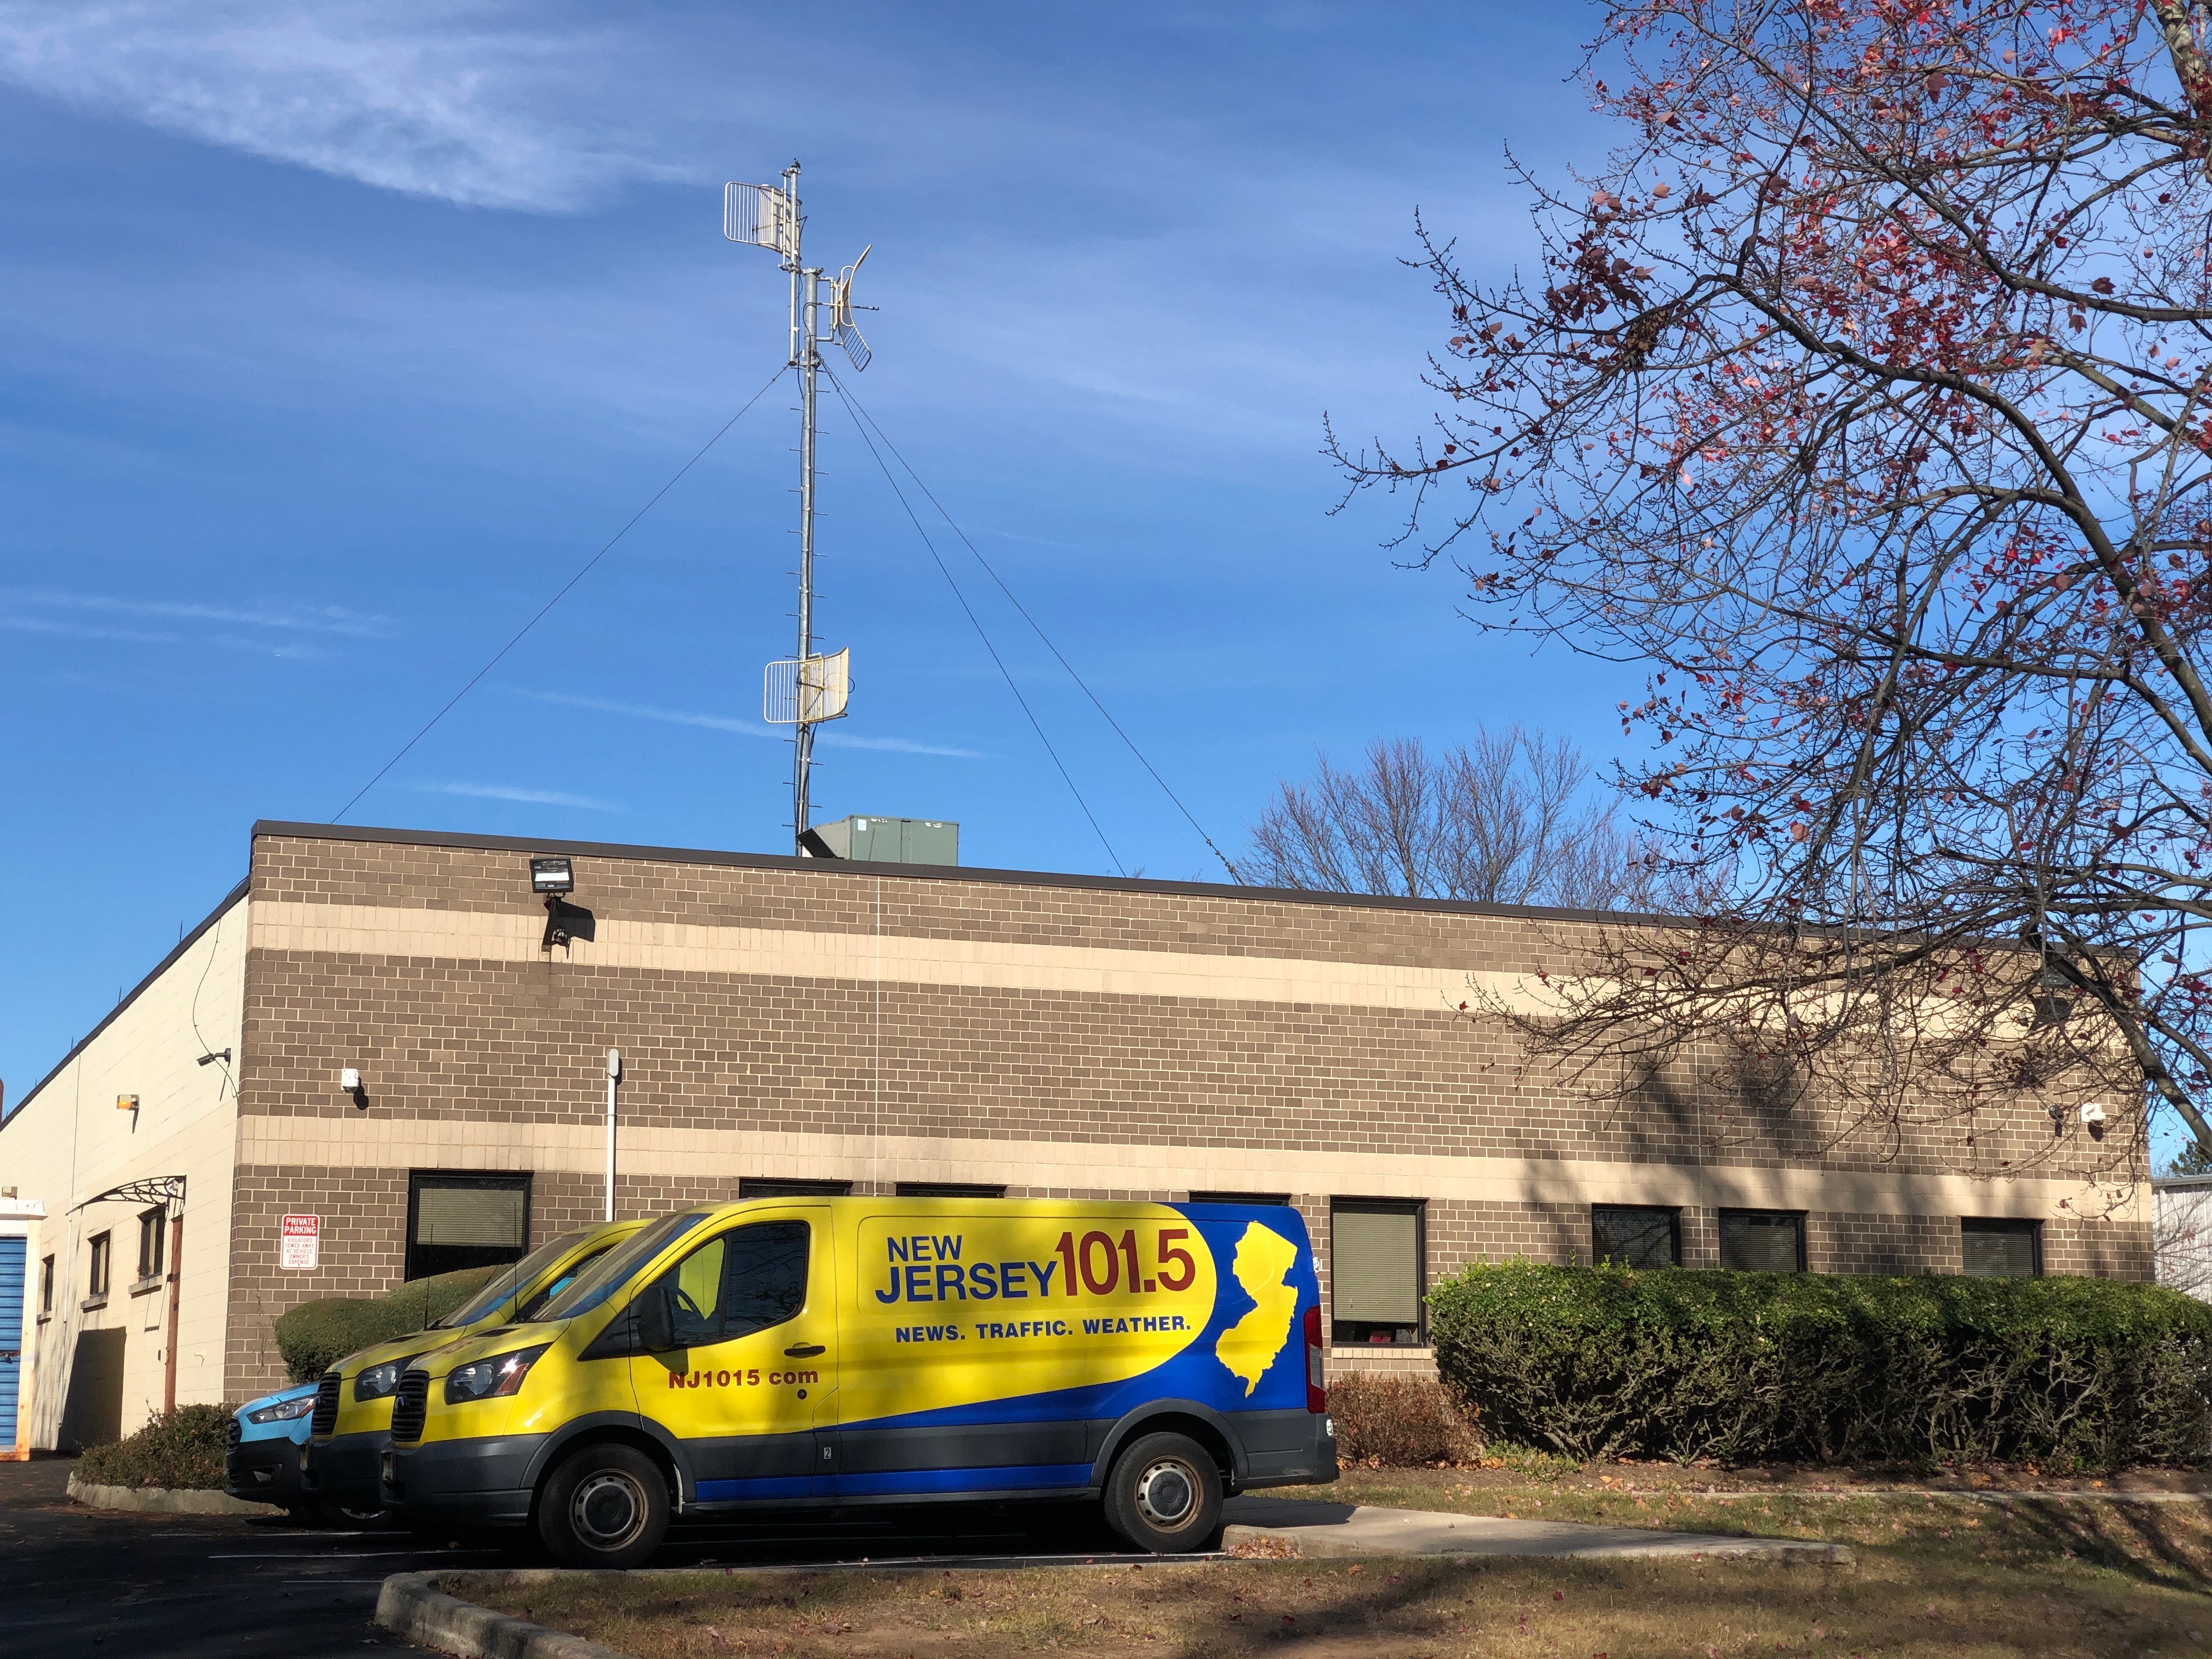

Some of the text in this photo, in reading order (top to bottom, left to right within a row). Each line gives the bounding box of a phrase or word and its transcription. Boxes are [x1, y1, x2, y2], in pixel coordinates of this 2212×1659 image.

[284, 1226, 317, 1234] PARKING
[286, 1217, 317, 1226] PRIVATE
[887, 1235, 962, 1262] NEW
[876, 1229, 1196, 1304] JERSEY 101.5
[896, 1316, 1192, 1343] NEWS. TRAFFIC. WEATHER.
[825, 1448, 830, 1458] 2
